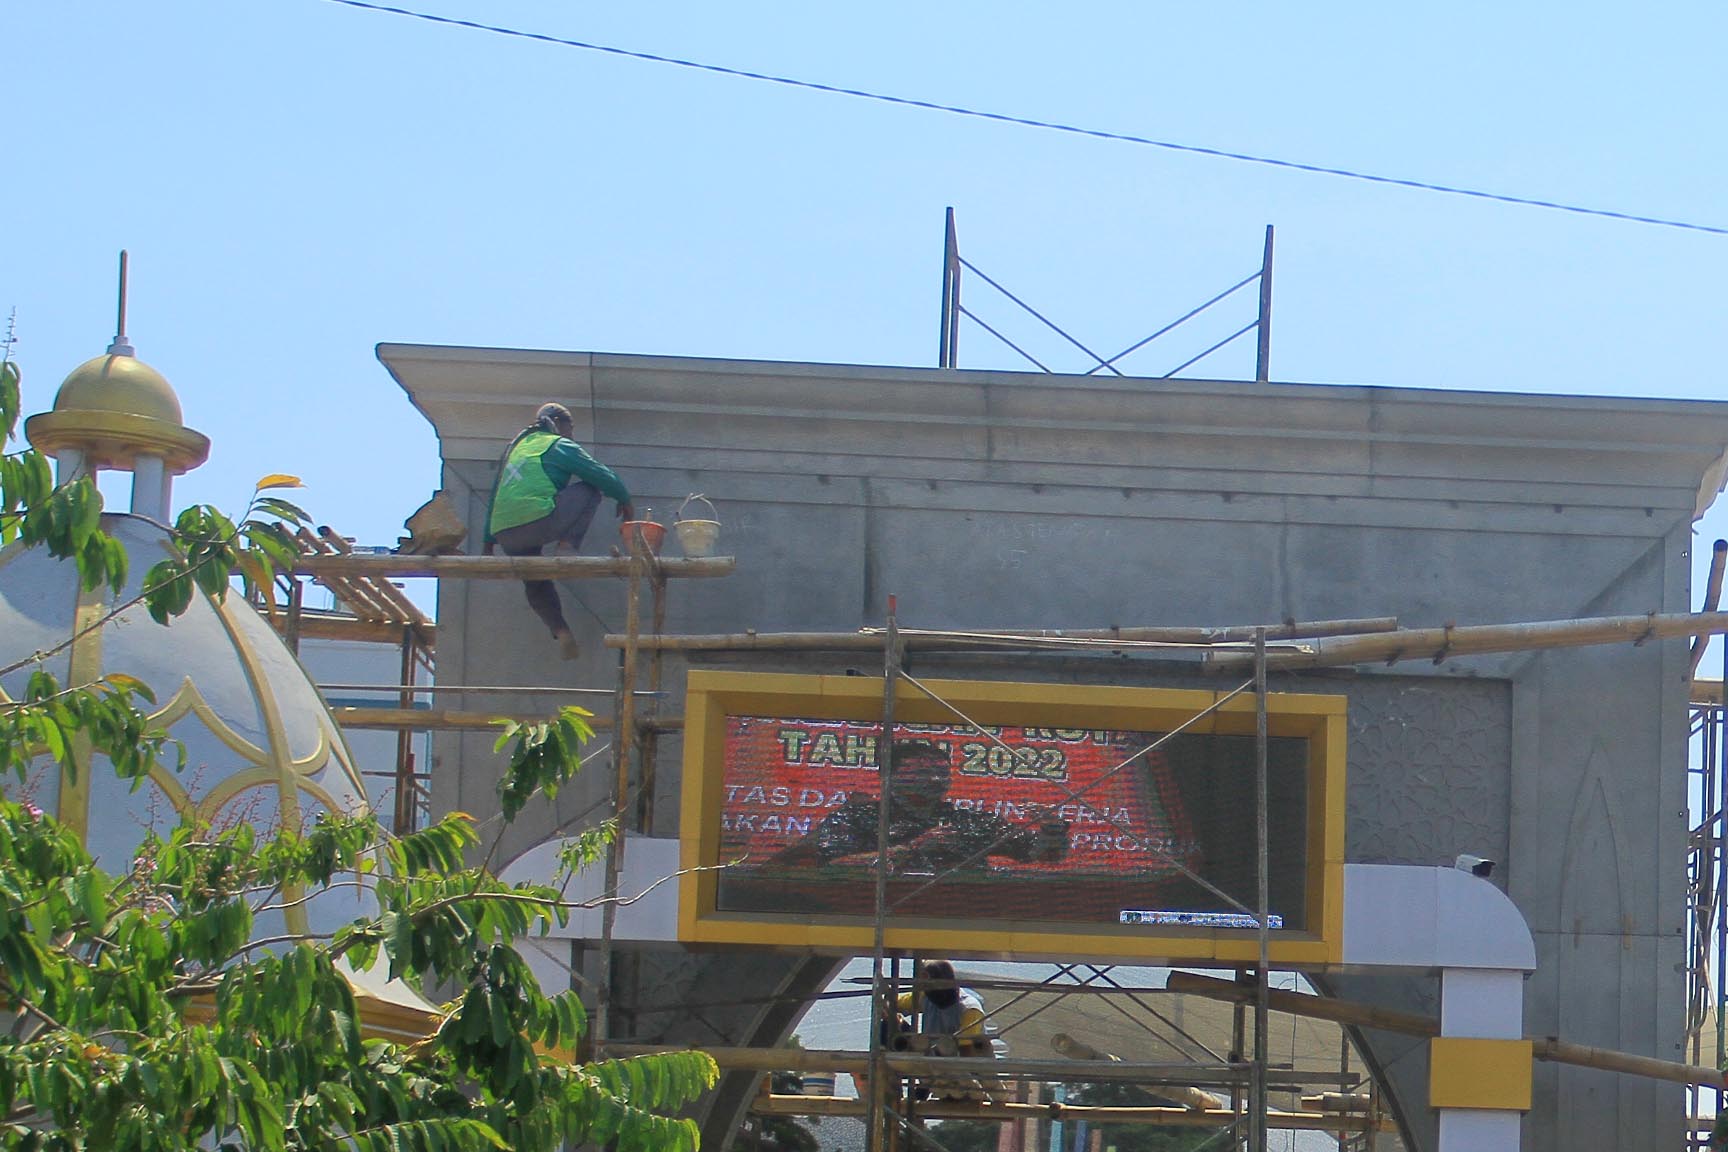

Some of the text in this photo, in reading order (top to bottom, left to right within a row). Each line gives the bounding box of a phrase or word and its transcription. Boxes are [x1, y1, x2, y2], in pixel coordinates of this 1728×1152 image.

[778, 729, 1068, 781] TAH 2022
[799, 789, 852, 808] DA
